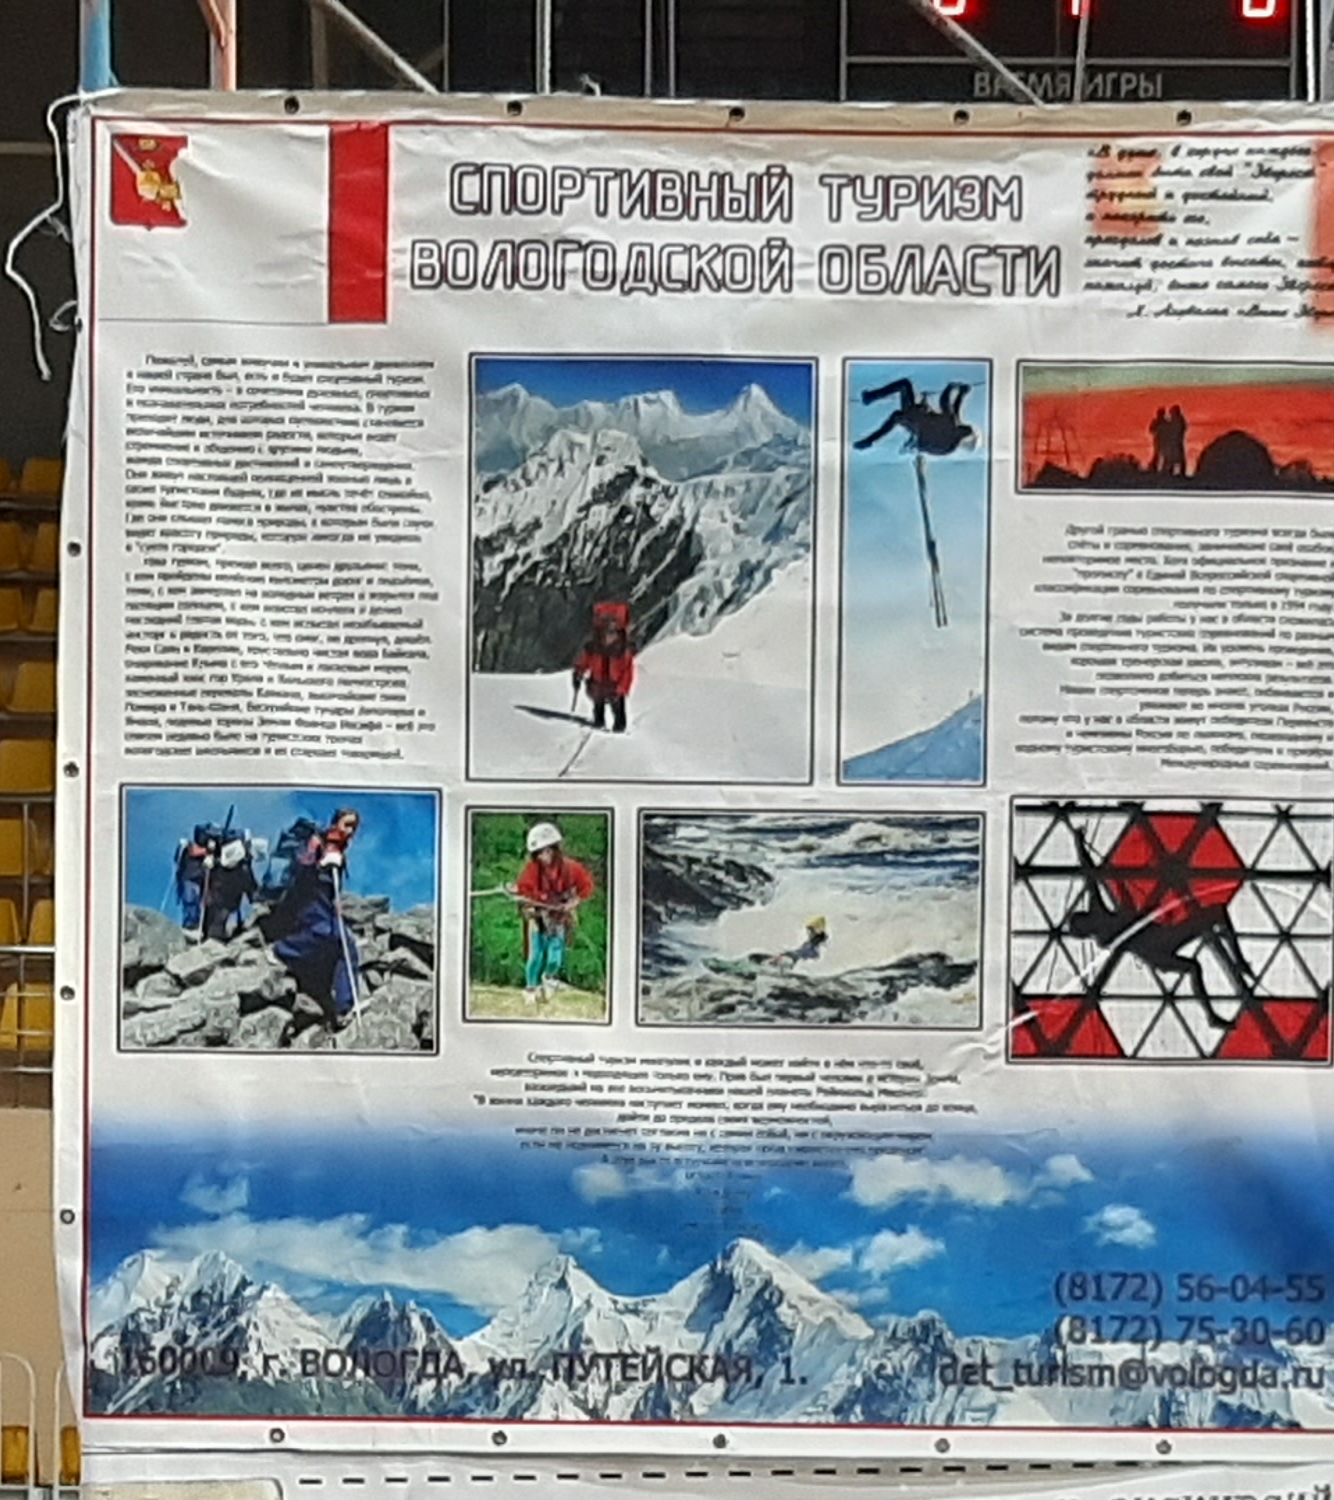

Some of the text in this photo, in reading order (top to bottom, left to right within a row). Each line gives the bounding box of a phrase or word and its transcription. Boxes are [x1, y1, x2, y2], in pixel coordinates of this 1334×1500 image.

[448, 162, 1023, 222] СПОРТИВНЫЙ ТУРИЗМ
[410, 237, 1061, 298] ВОЛОГОДСКОЙ ОБЛАСТИ
[1054, 1271, 1326, 1309] (8172) 56-04-55
[1054, 1314, 1326, 1351] (8172) 75-30-60
[938, 1353, 1326, 1395] det_turism@vologda.ru
